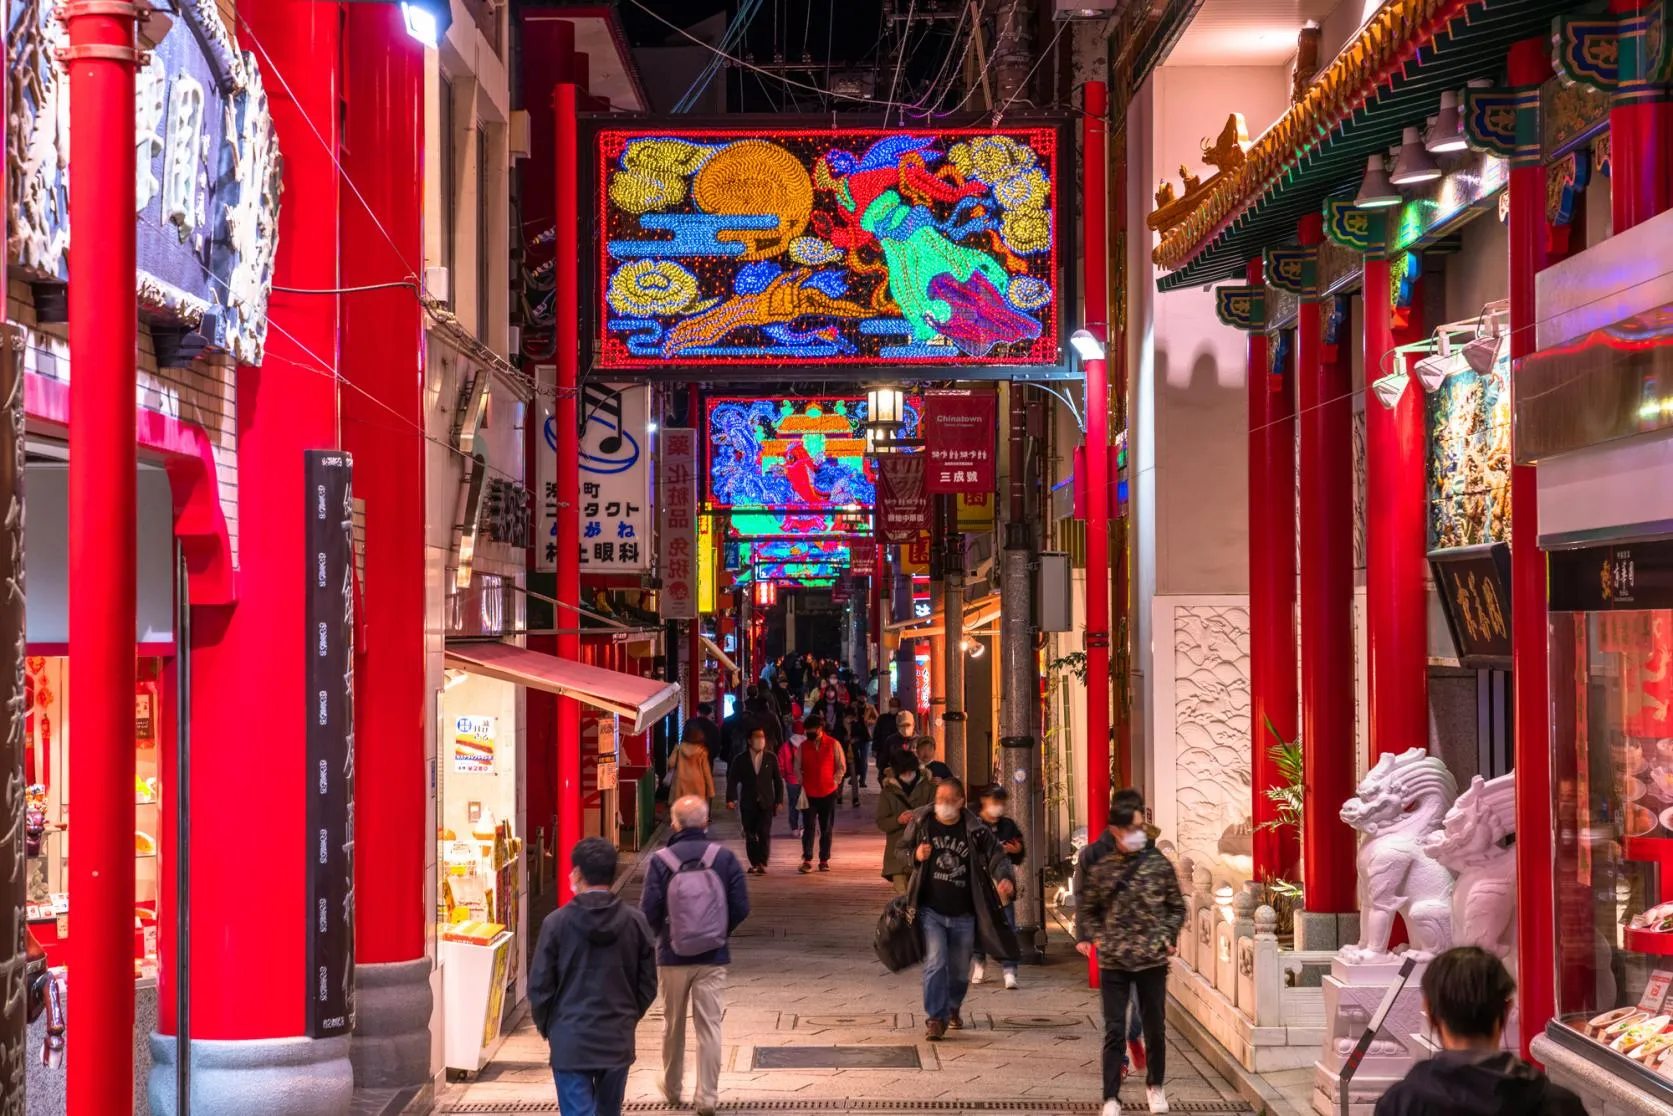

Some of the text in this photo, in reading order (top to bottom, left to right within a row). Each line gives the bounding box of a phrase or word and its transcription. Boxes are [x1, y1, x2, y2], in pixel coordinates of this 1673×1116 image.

[937, 415, 982, 423] Chinatown
[545, 501, 640, 518] コタクト
